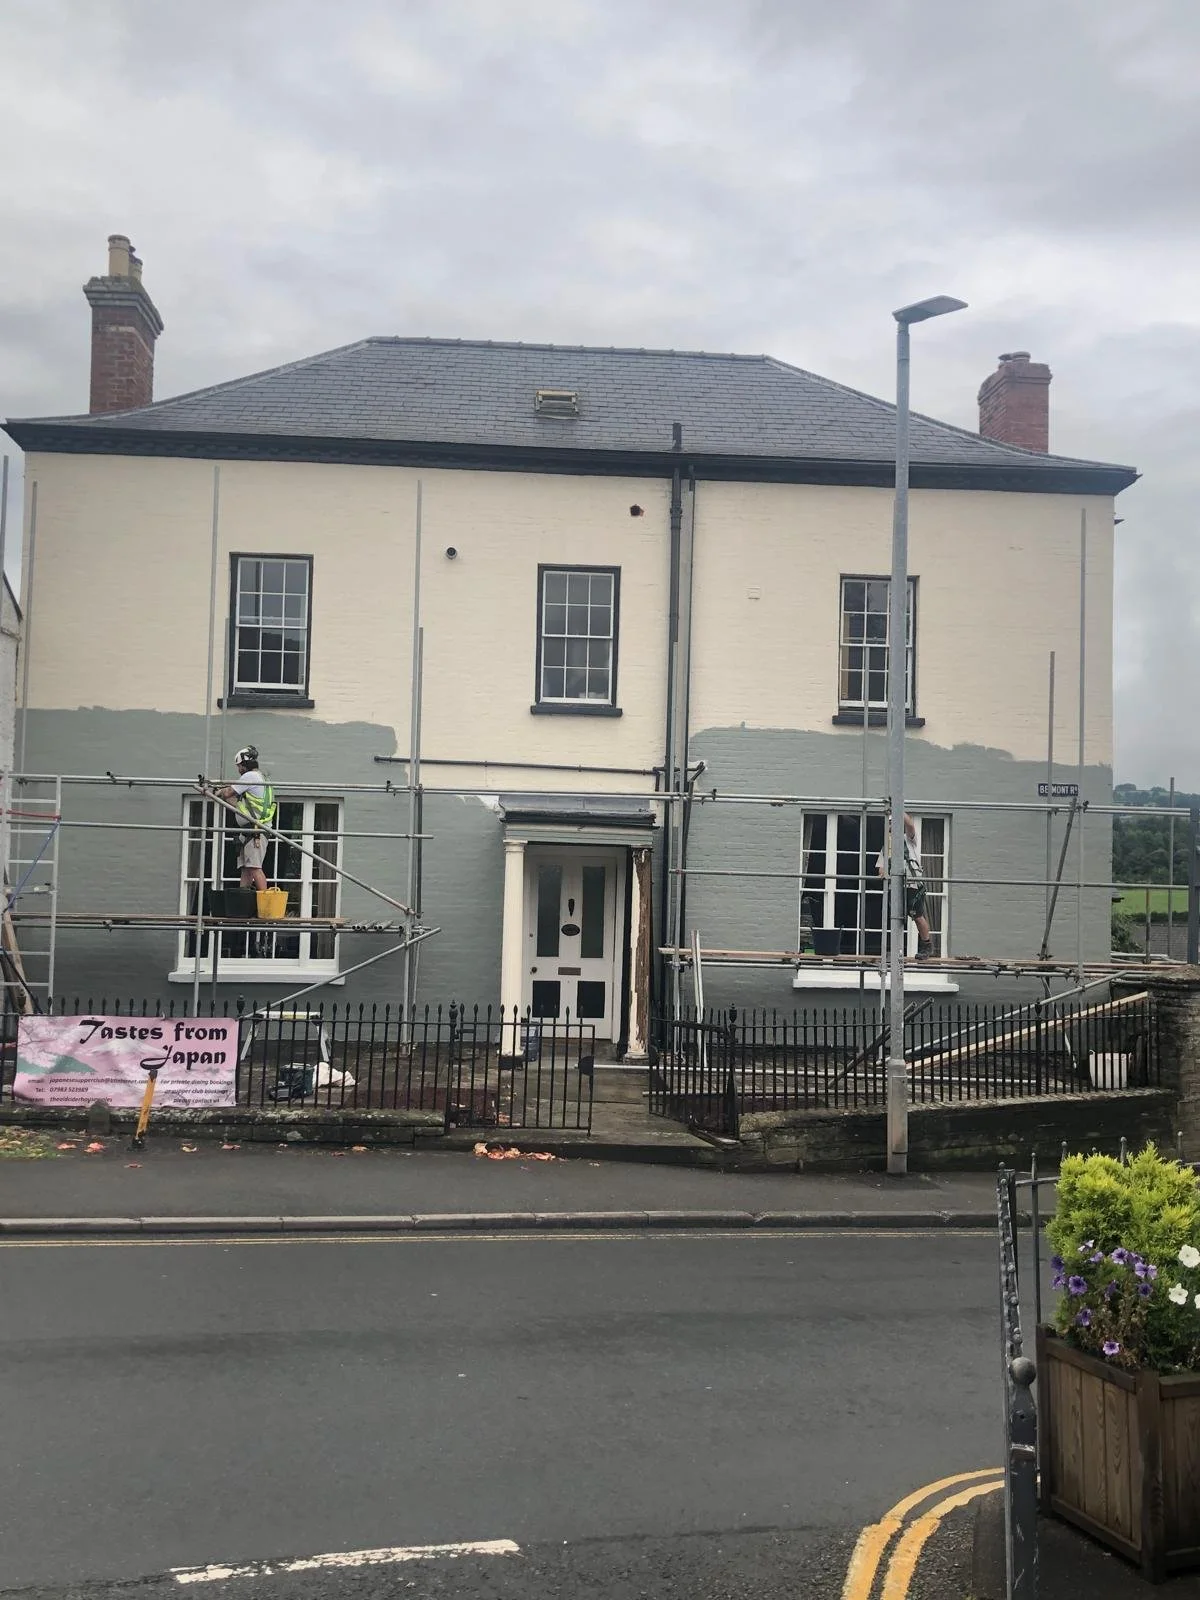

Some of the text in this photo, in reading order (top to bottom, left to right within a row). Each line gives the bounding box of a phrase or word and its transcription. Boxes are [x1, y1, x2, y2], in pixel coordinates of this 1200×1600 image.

[1040, 785, 1069, 794] BEMONT
[79, 1019, 228, 1045] Tastes from
[139, 1044, 227, 1071] Japan
